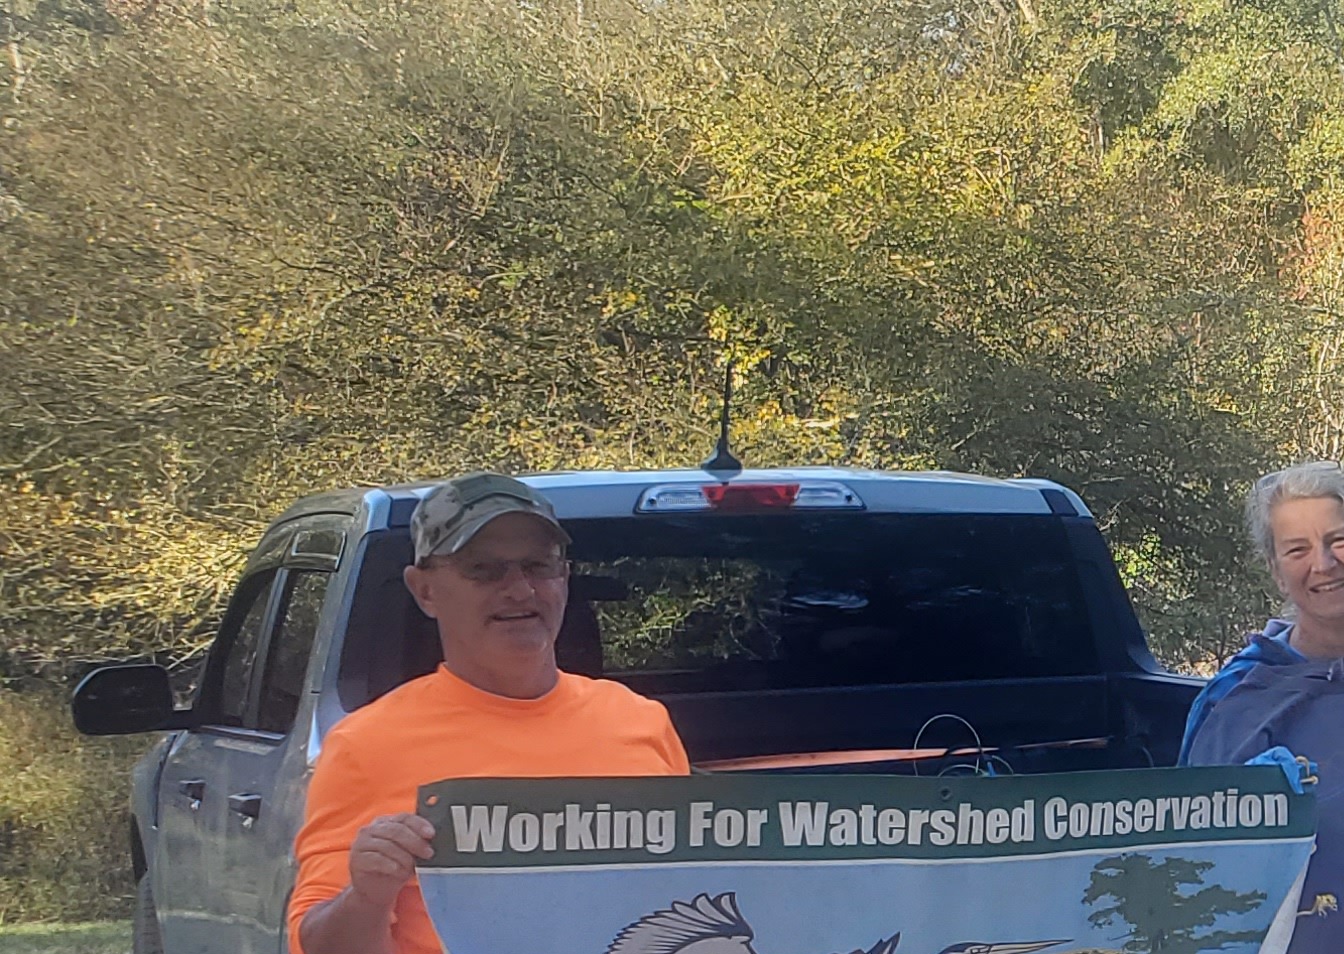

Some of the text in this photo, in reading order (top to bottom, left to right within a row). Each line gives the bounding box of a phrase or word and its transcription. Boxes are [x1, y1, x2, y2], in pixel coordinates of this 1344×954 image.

[450, 788, 1289, 854] Working For Watershed Conservation
